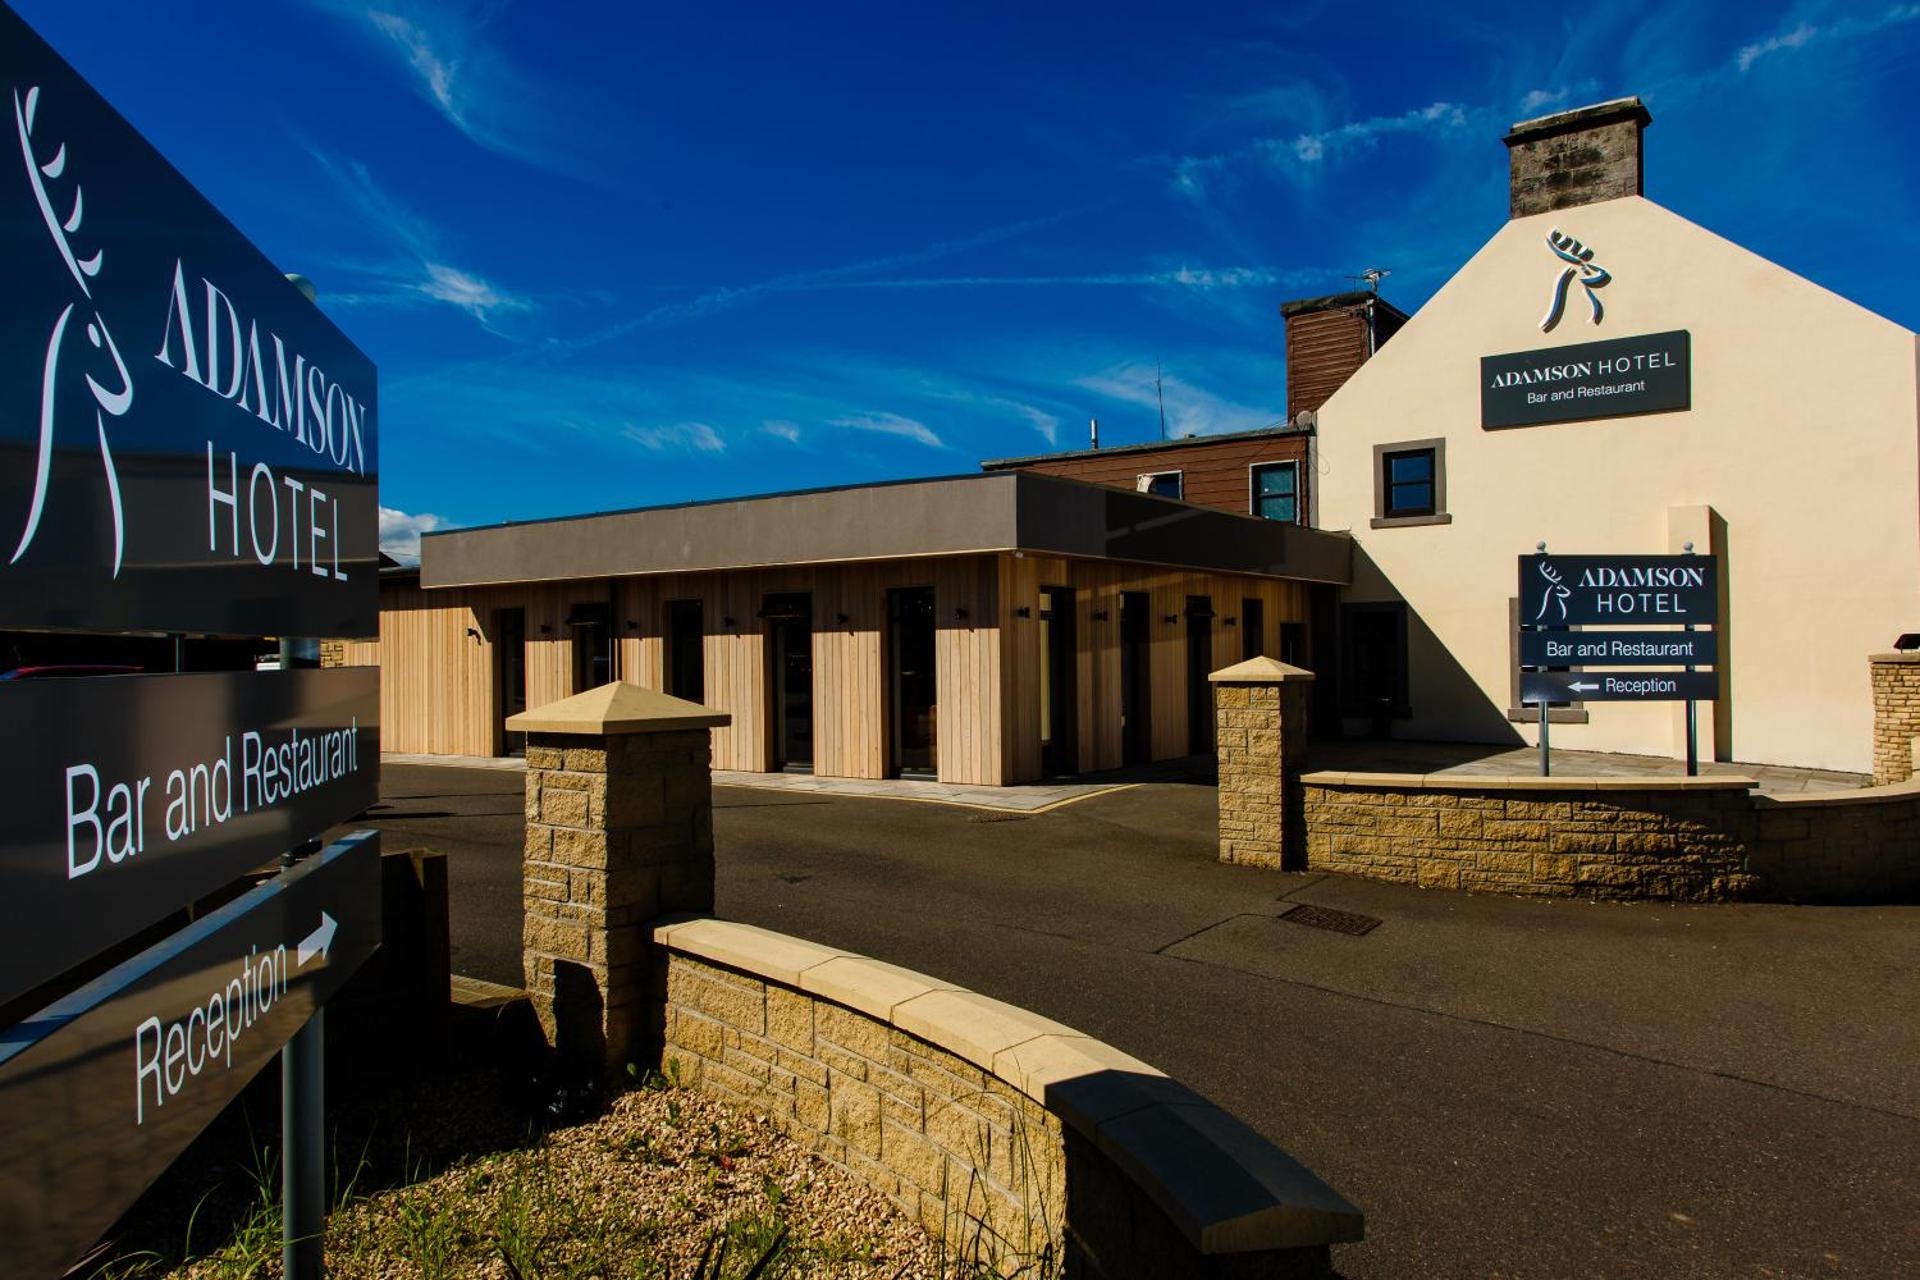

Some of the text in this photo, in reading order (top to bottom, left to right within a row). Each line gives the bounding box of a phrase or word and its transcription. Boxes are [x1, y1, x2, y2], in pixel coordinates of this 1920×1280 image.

[154, 257, 366, 477] ADAMSON
[1491, 351, 1676, 389] ADAMSON HOTEL
[1527, 380, 1645, 404] Bar and Restaurant
[207, 440, 348, 581] HOTEL
[1578, 567, 1704, 587] ADAMSON
[1597, 593, 1687, 613] HOTEL
[1546, 641, 1693, 656] Bar and Restaurant
[1605, 677, 1676, 695] Reception
[66, 716, 358, 880] Bar and Restaurant
[136, 942, 287, 1125] Reception
